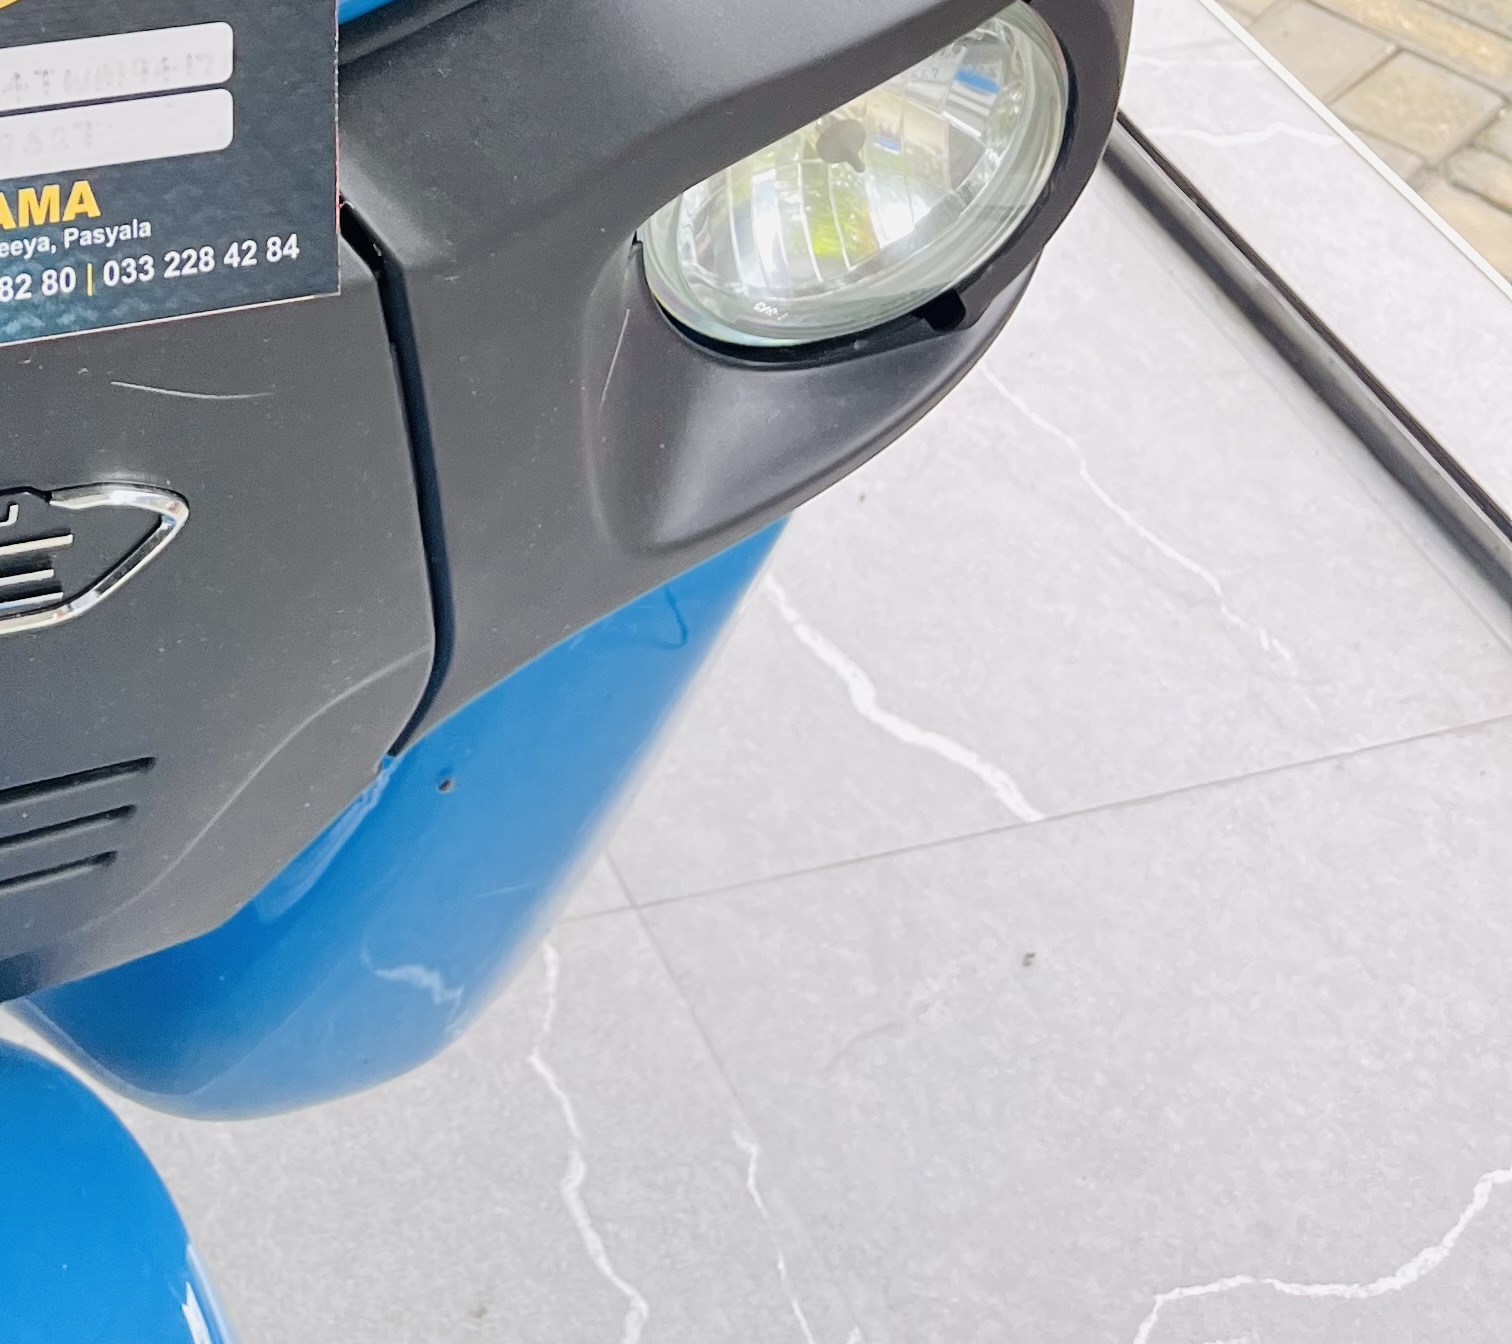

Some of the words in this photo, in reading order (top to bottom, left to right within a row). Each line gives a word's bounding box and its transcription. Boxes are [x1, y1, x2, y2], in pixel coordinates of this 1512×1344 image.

[63, 218, 152, 249] Pasyala
[40, 266, 77, 298] 80
[102, 254, 156, 287] 033
[163, 245, 216, 279] 228
[222, 238, 258, 270] 42
[265, 233, 301, 263] 84
